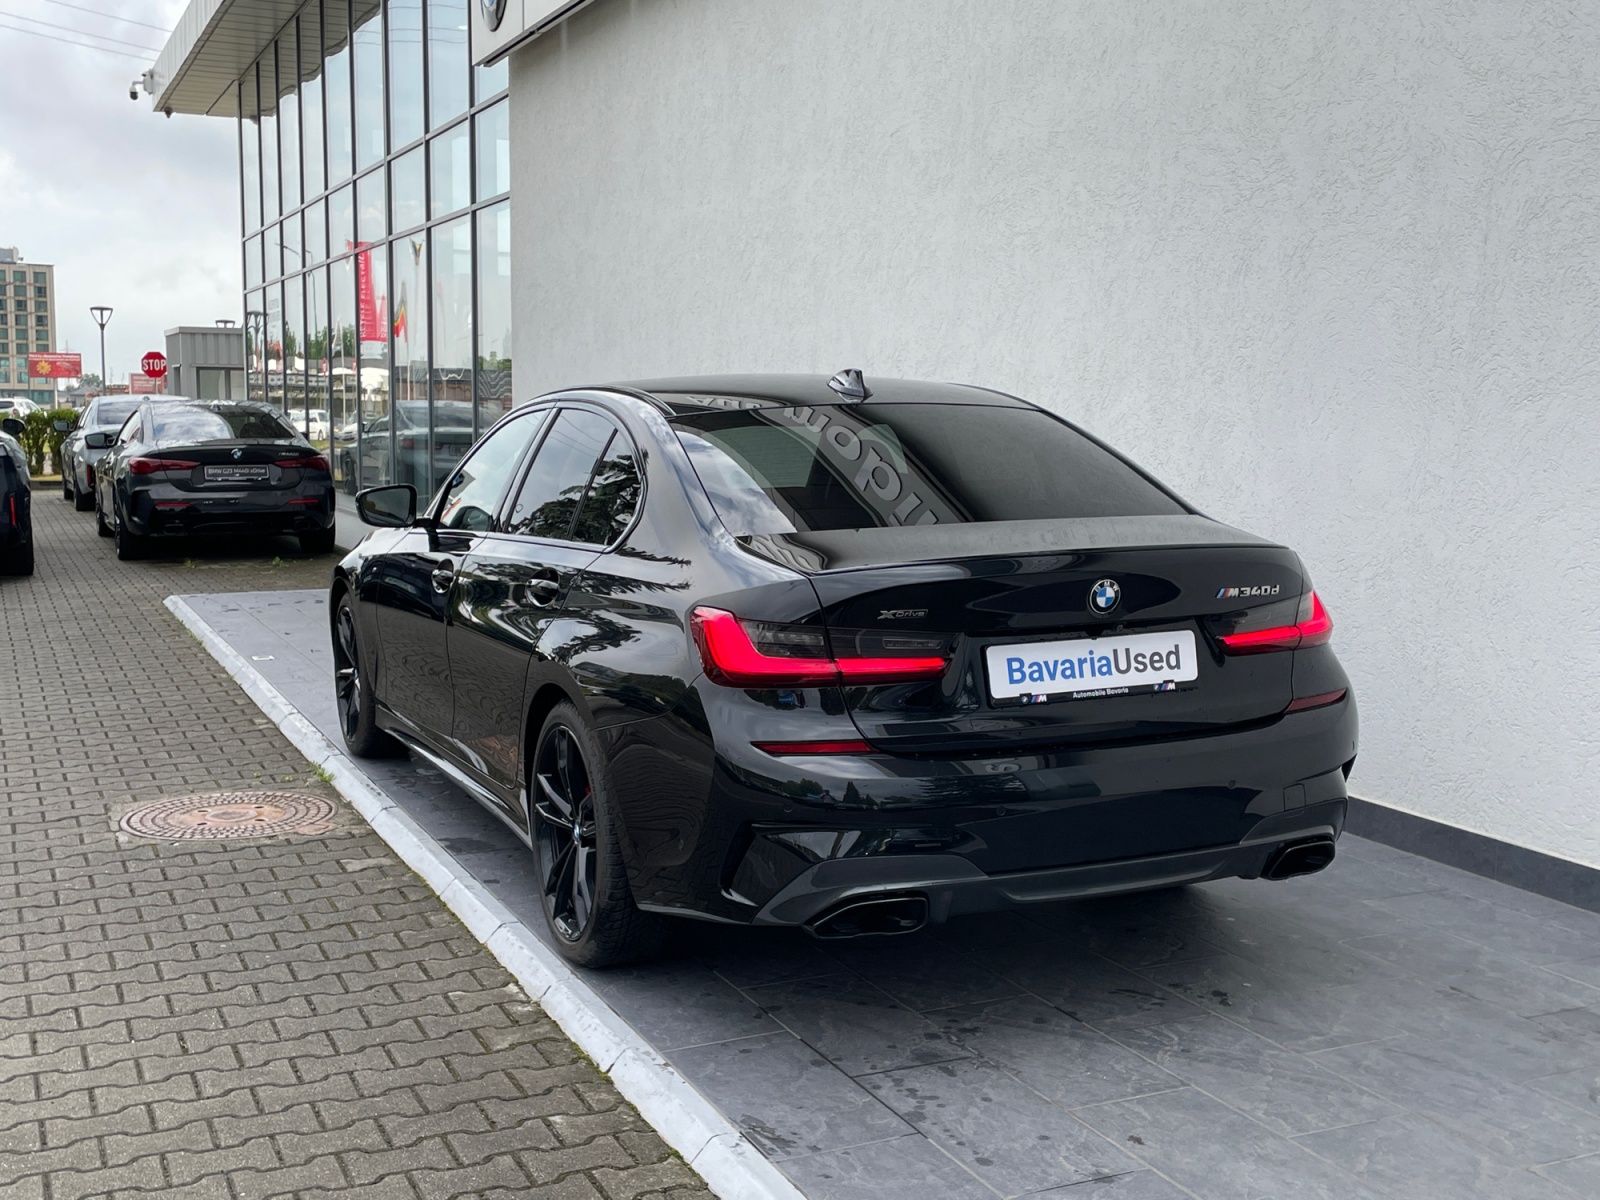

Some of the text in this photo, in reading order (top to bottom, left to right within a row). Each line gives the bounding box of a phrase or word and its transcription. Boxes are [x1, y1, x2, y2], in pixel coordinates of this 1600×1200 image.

[142, 359, 166, 371] STOP
[1227, 584, 1280, 598] M340d
[1007, 644, 1181, 684] BavariaUsed
[1073, 687, 1129, 698] Automobile Bavaria
